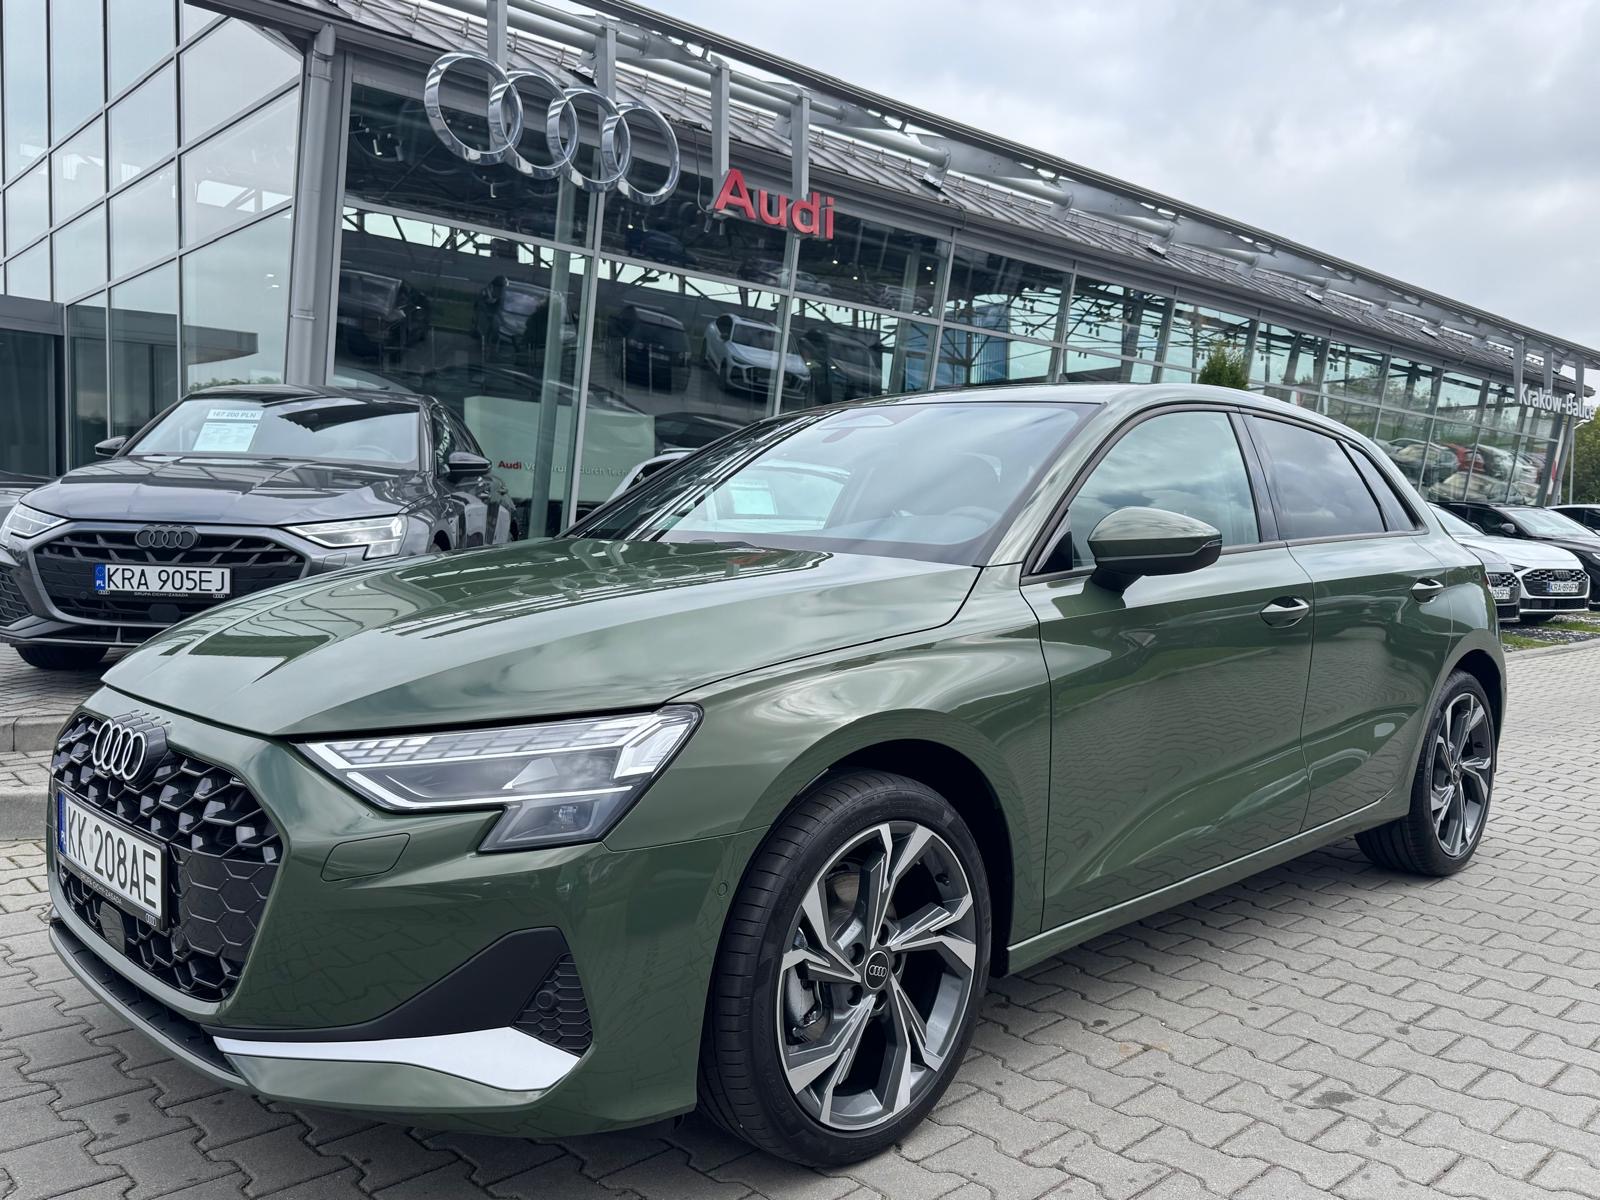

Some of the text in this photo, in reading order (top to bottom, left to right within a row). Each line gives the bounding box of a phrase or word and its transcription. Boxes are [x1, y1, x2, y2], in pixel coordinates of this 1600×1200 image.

[713, 167, 835, 240] Audi
[497, 460, 522, 470] Audi
[96, 579, 105, 587] PL
[107, 567, 225, 592] KRA 905EJ
[68, 806, 157, 910] KK 208AE
